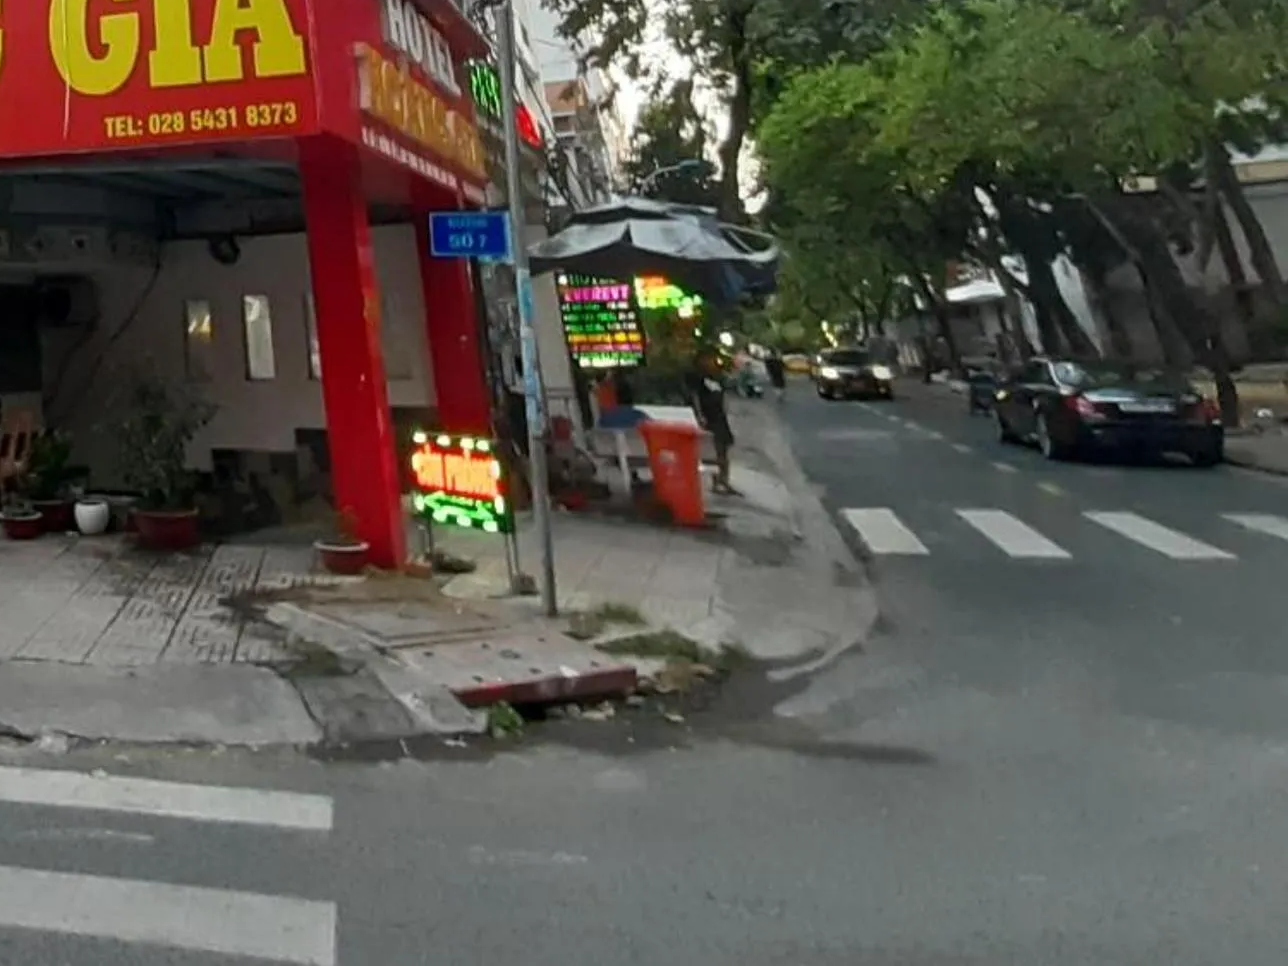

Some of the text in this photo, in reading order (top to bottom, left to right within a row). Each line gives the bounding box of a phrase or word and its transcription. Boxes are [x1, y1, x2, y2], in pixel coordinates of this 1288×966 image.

[103, 101, 297, 139] TEL: 028 5431 8373
